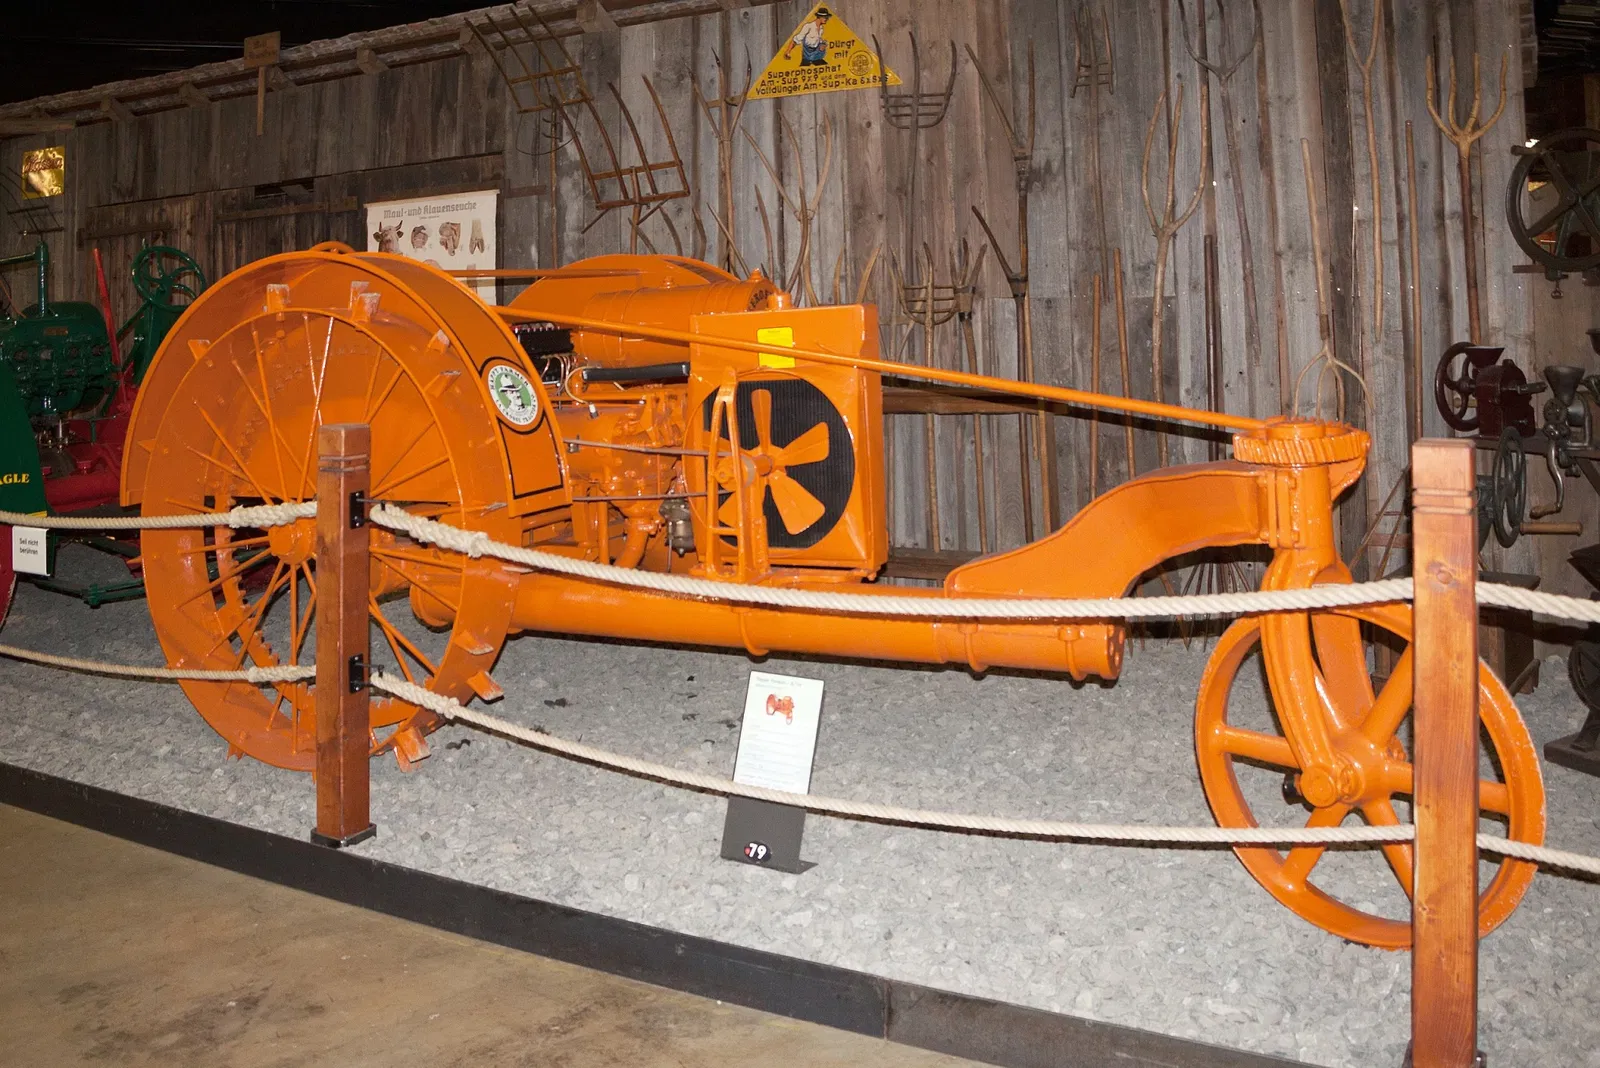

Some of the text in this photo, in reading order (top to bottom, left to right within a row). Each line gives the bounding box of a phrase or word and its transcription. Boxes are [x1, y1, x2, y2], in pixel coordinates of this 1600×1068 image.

[834, 50, 848, 59] mit
[767, 64, 841, 79] Superphosphat
[756, 84, 801, 96] Volldünger
[423, 201, 477, 215] Klauenseuche
[490, 367, 528, 390] HAPPY FARMER
[28, 538, 39, 546] nicht
[19, 546, 39, 555] berühren
[748, 842, 767, 860] 79
